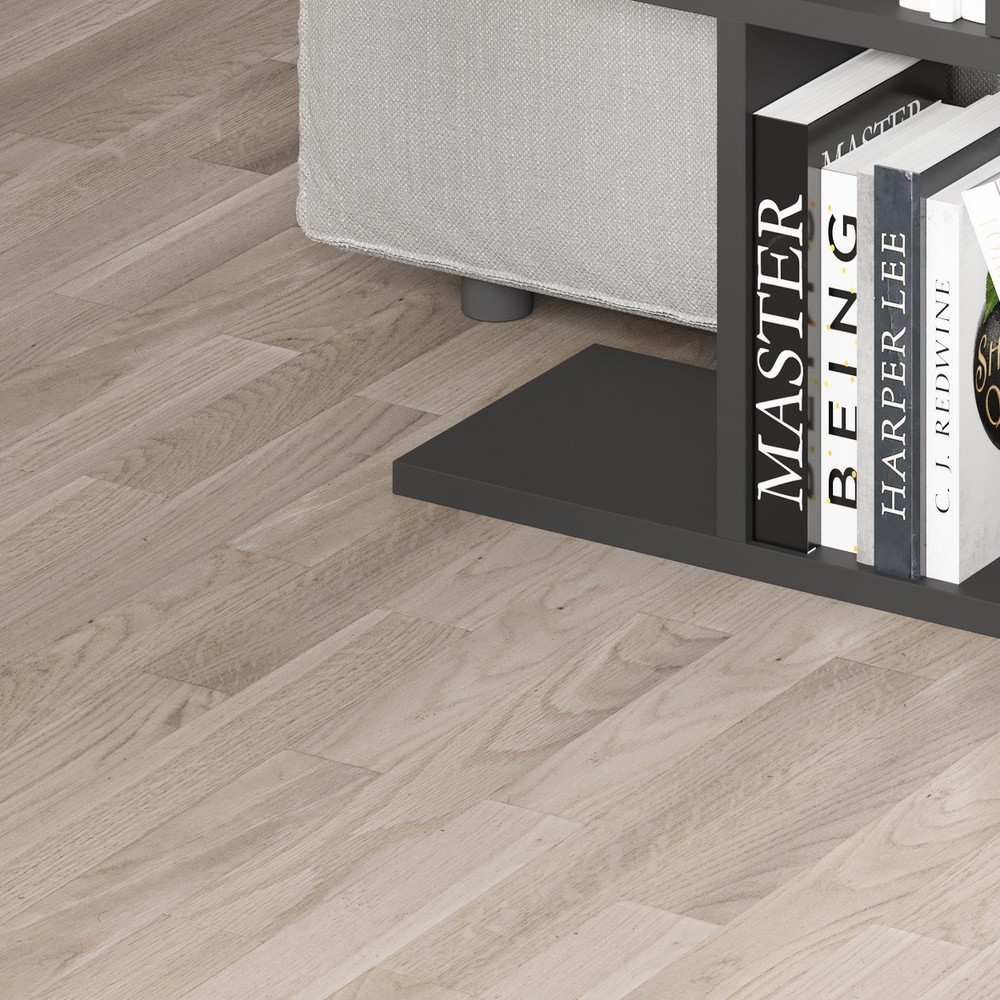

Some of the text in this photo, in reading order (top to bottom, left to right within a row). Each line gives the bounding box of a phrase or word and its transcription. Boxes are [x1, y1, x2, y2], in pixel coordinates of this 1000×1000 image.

[757, 194, 804, 512] MASTER
[828, 214, 858, 509] BEING
[881, 231, 907, 521] HARPER LEE
[934, 278, 952, 514] C. J. REDWINE
